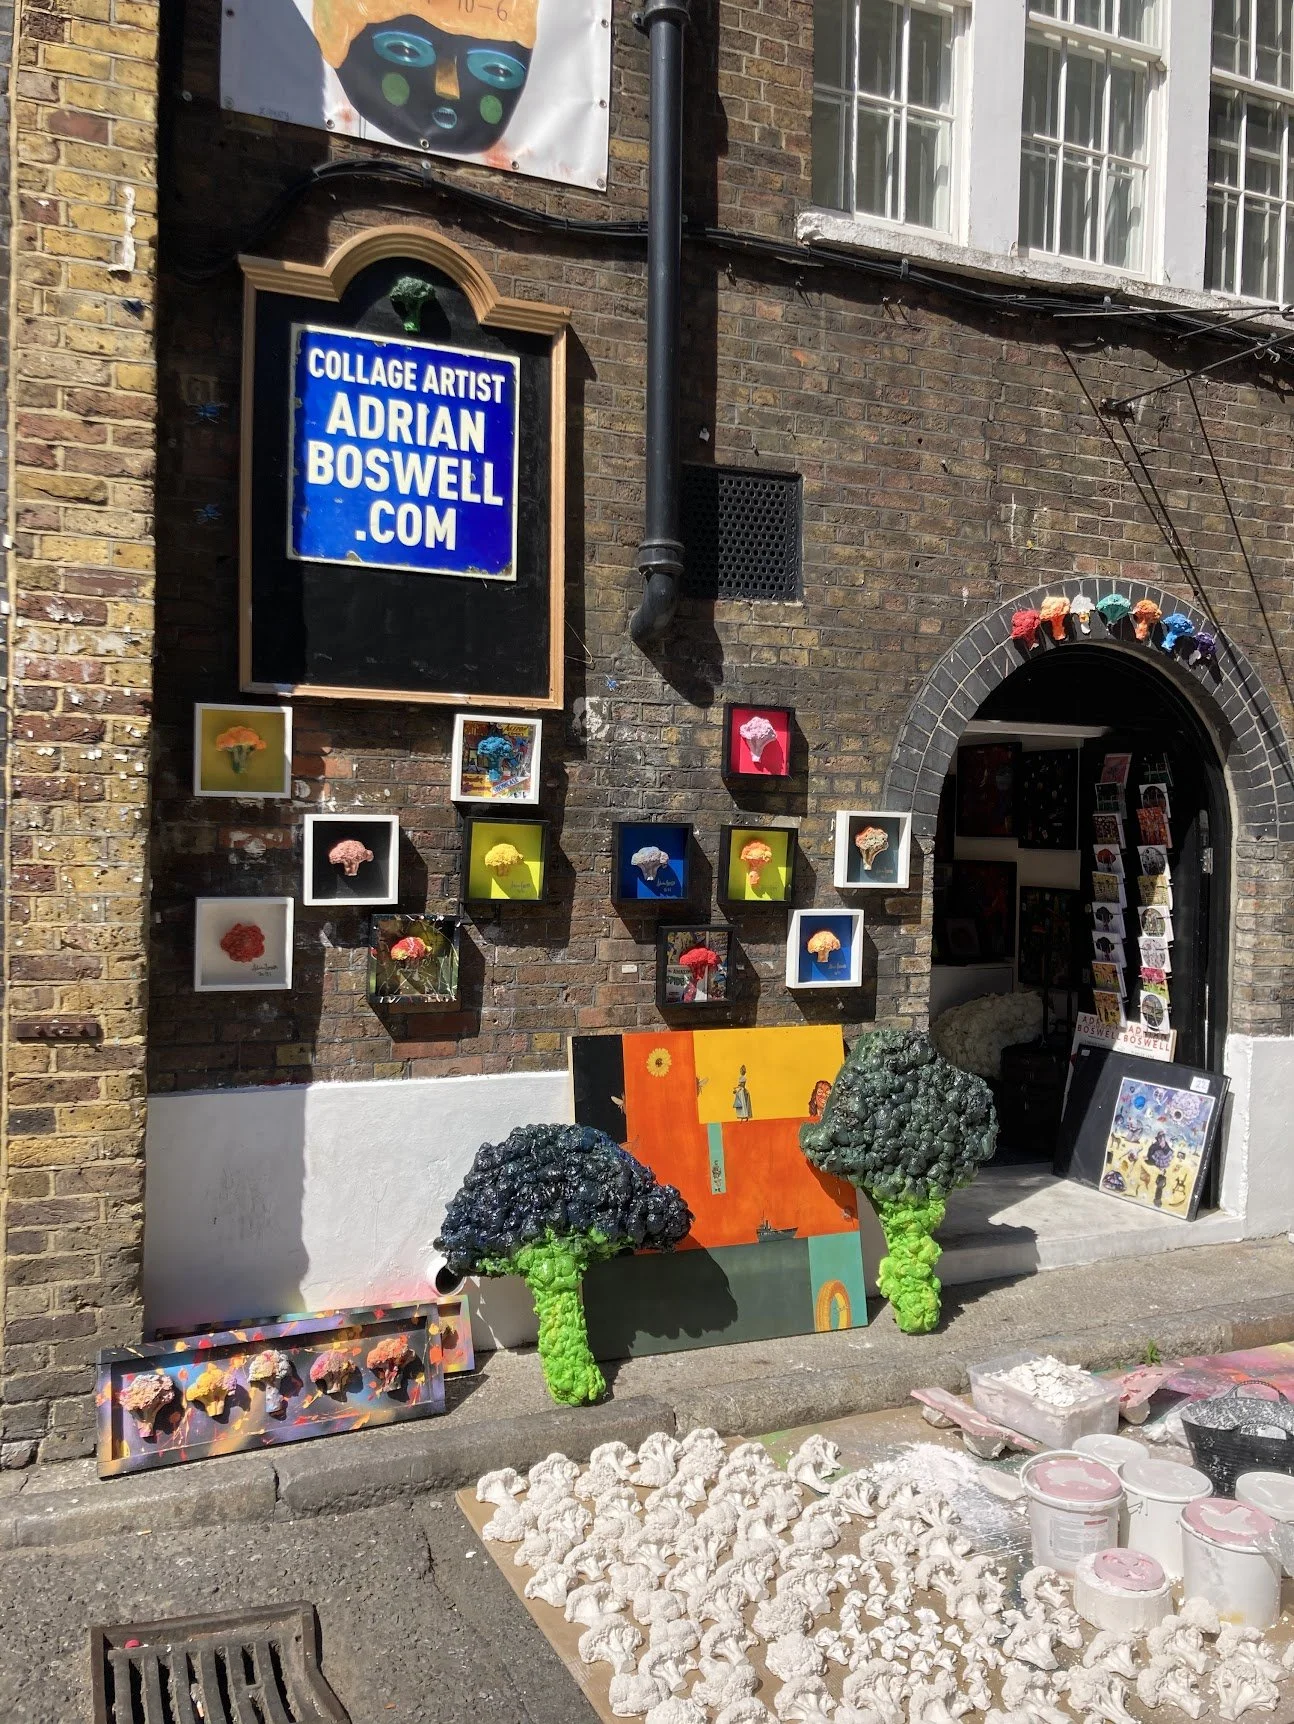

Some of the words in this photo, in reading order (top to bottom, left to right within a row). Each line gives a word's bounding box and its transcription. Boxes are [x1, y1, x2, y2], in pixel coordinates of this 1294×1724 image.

[308, 347, 418, 392] COLLAGE
[422, 365, 506, 404] ARTIST
[326, 391, 485, 454] ADRIAN
[307, 440, 503, 506] BOSWELL
[355, 500, 456, 551] .COM
[1123, 1035, 1170, 1051] BOSWELL
